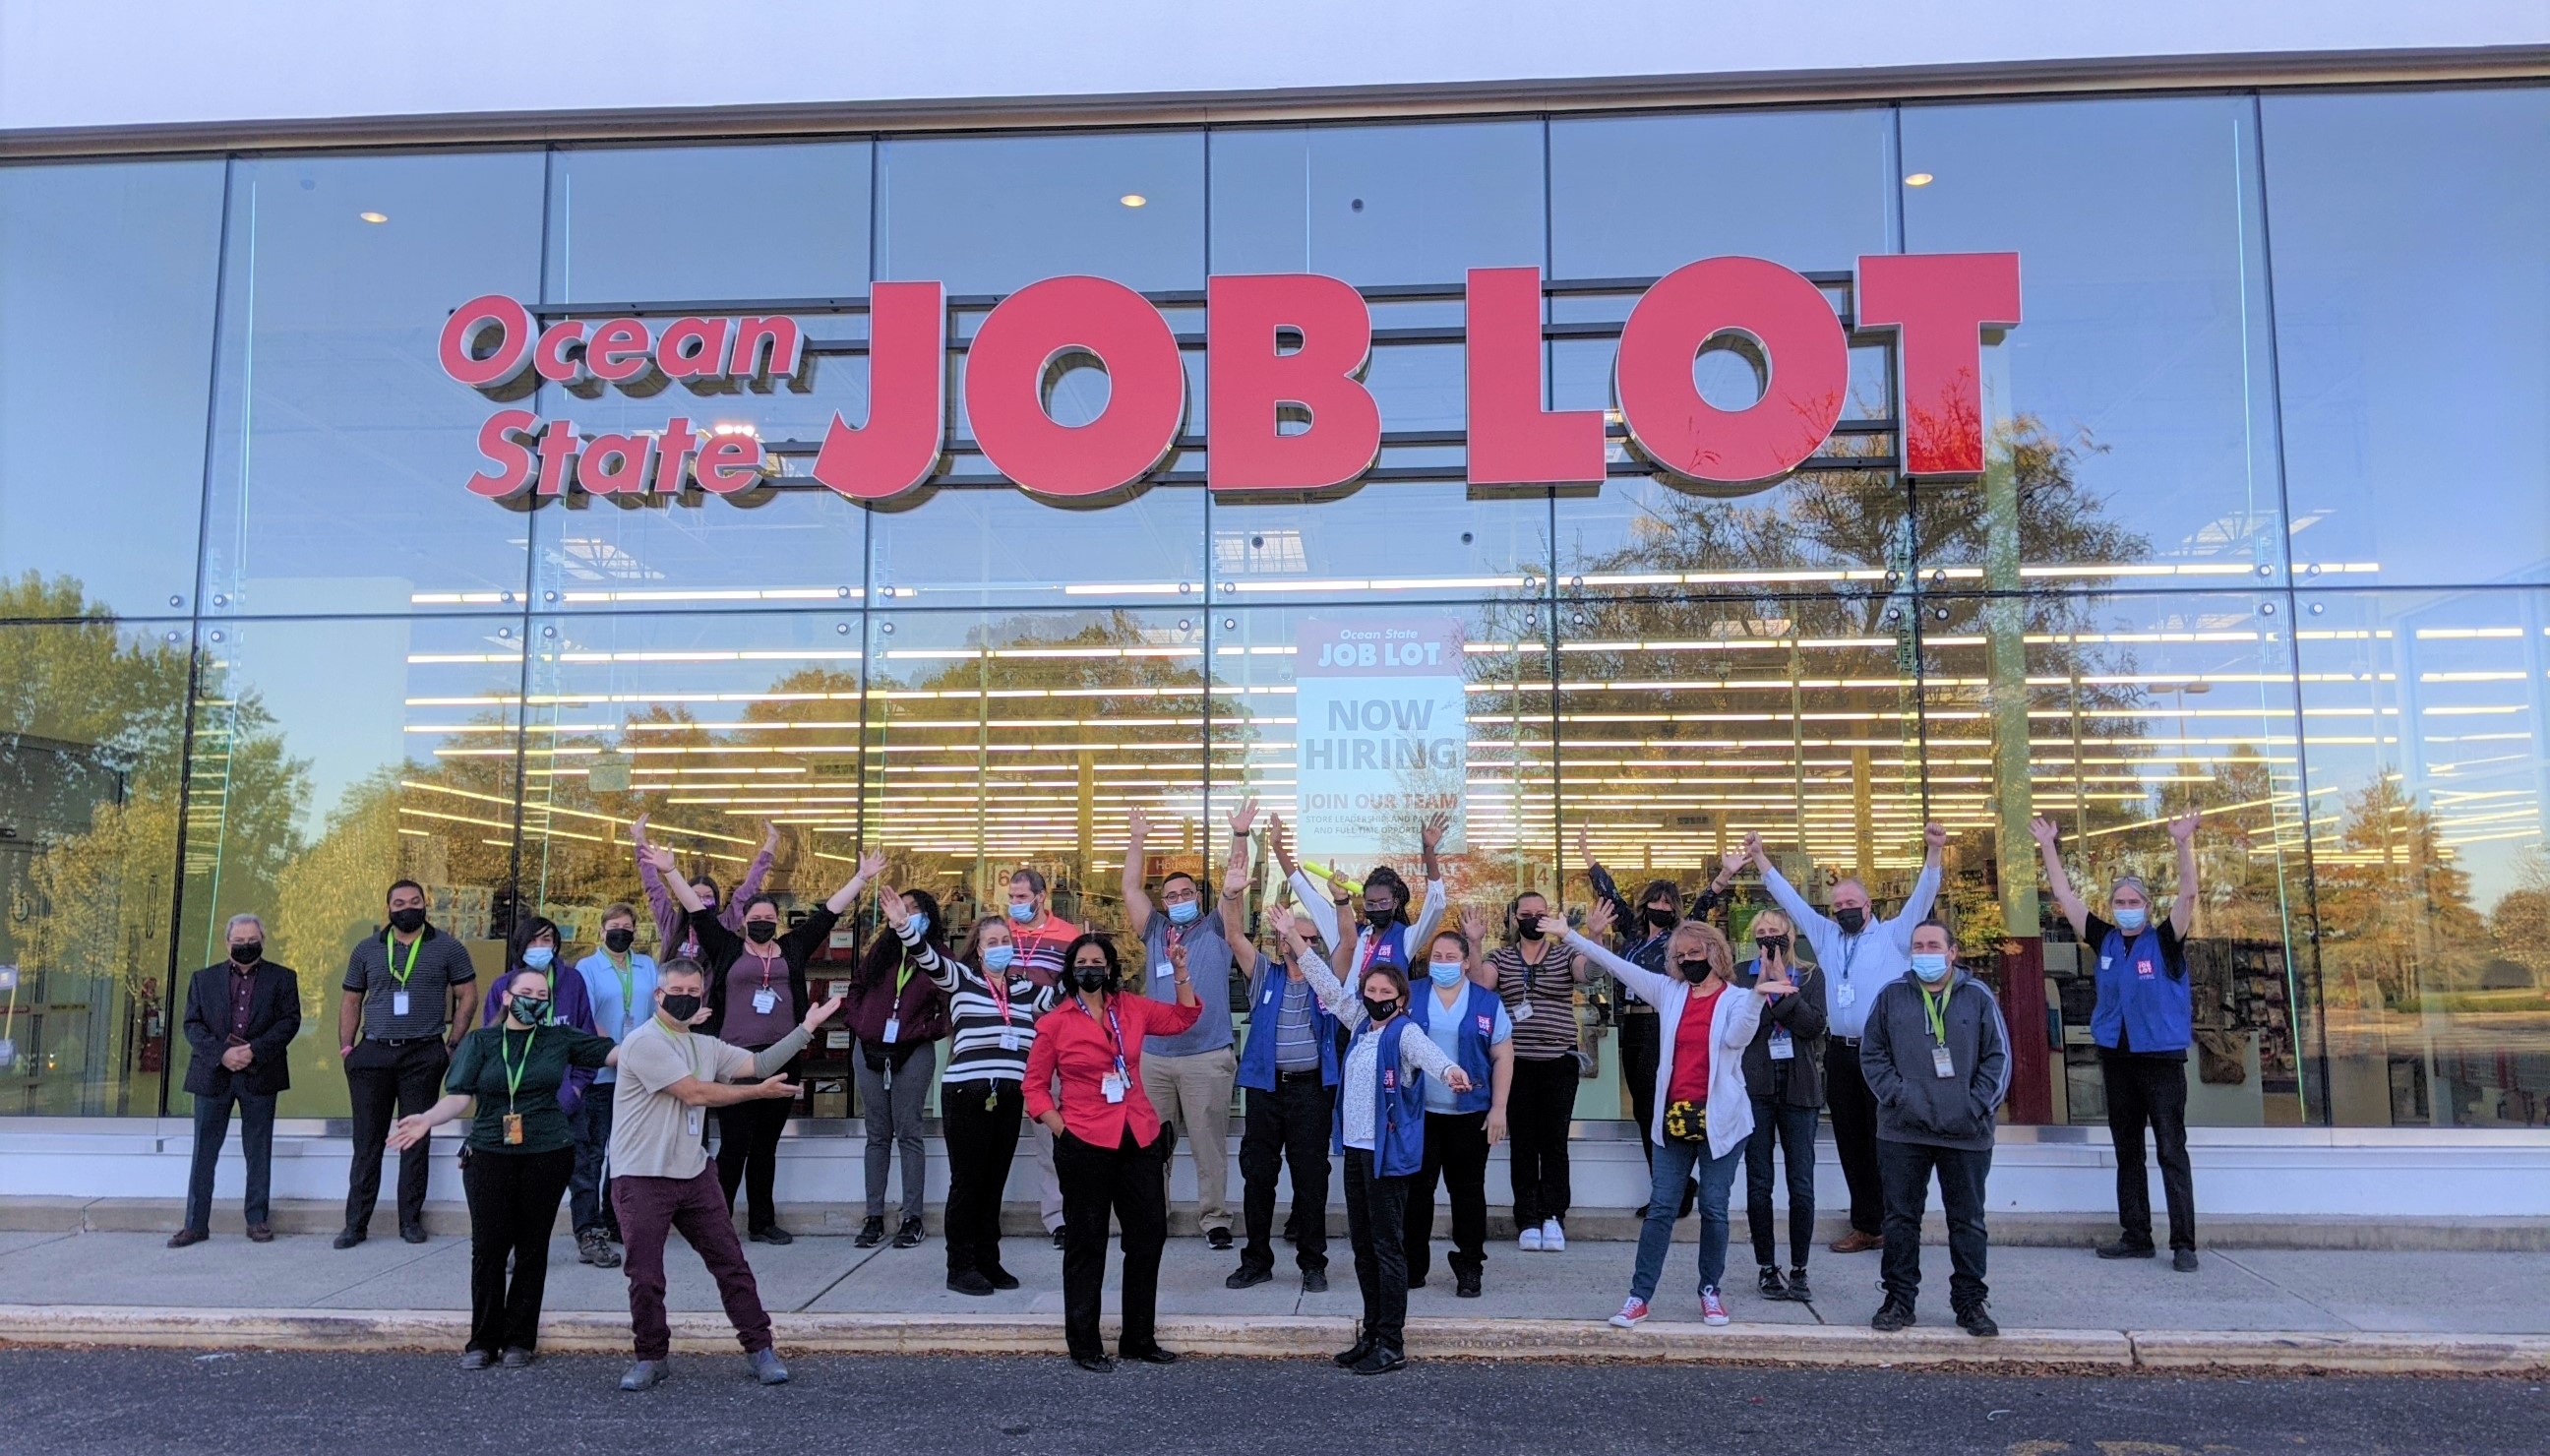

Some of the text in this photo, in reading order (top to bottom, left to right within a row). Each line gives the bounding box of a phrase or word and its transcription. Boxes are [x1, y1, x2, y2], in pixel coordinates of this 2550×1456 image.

[438, 294, 806, 390] Ocean
[812, 252, 2022, 500] JOB LOT
[464, 409, 766, 500] State
[1340, 629, 1418, 639] Ocean State
[1318, 642, 1441, 667] JOB LOT
[1328, 699, 1434, 731] NOW
[1305, 738, 1457, 769] HIRING
[1303, 794, 1458, 813] JOIN OUR TEAM
[1156, 860, 1203, 871] Housew
[1537, 868, 1548, 885] 4
[1826, 867, 1838, 885] 3
[999, 870, 1009, 886] 6
